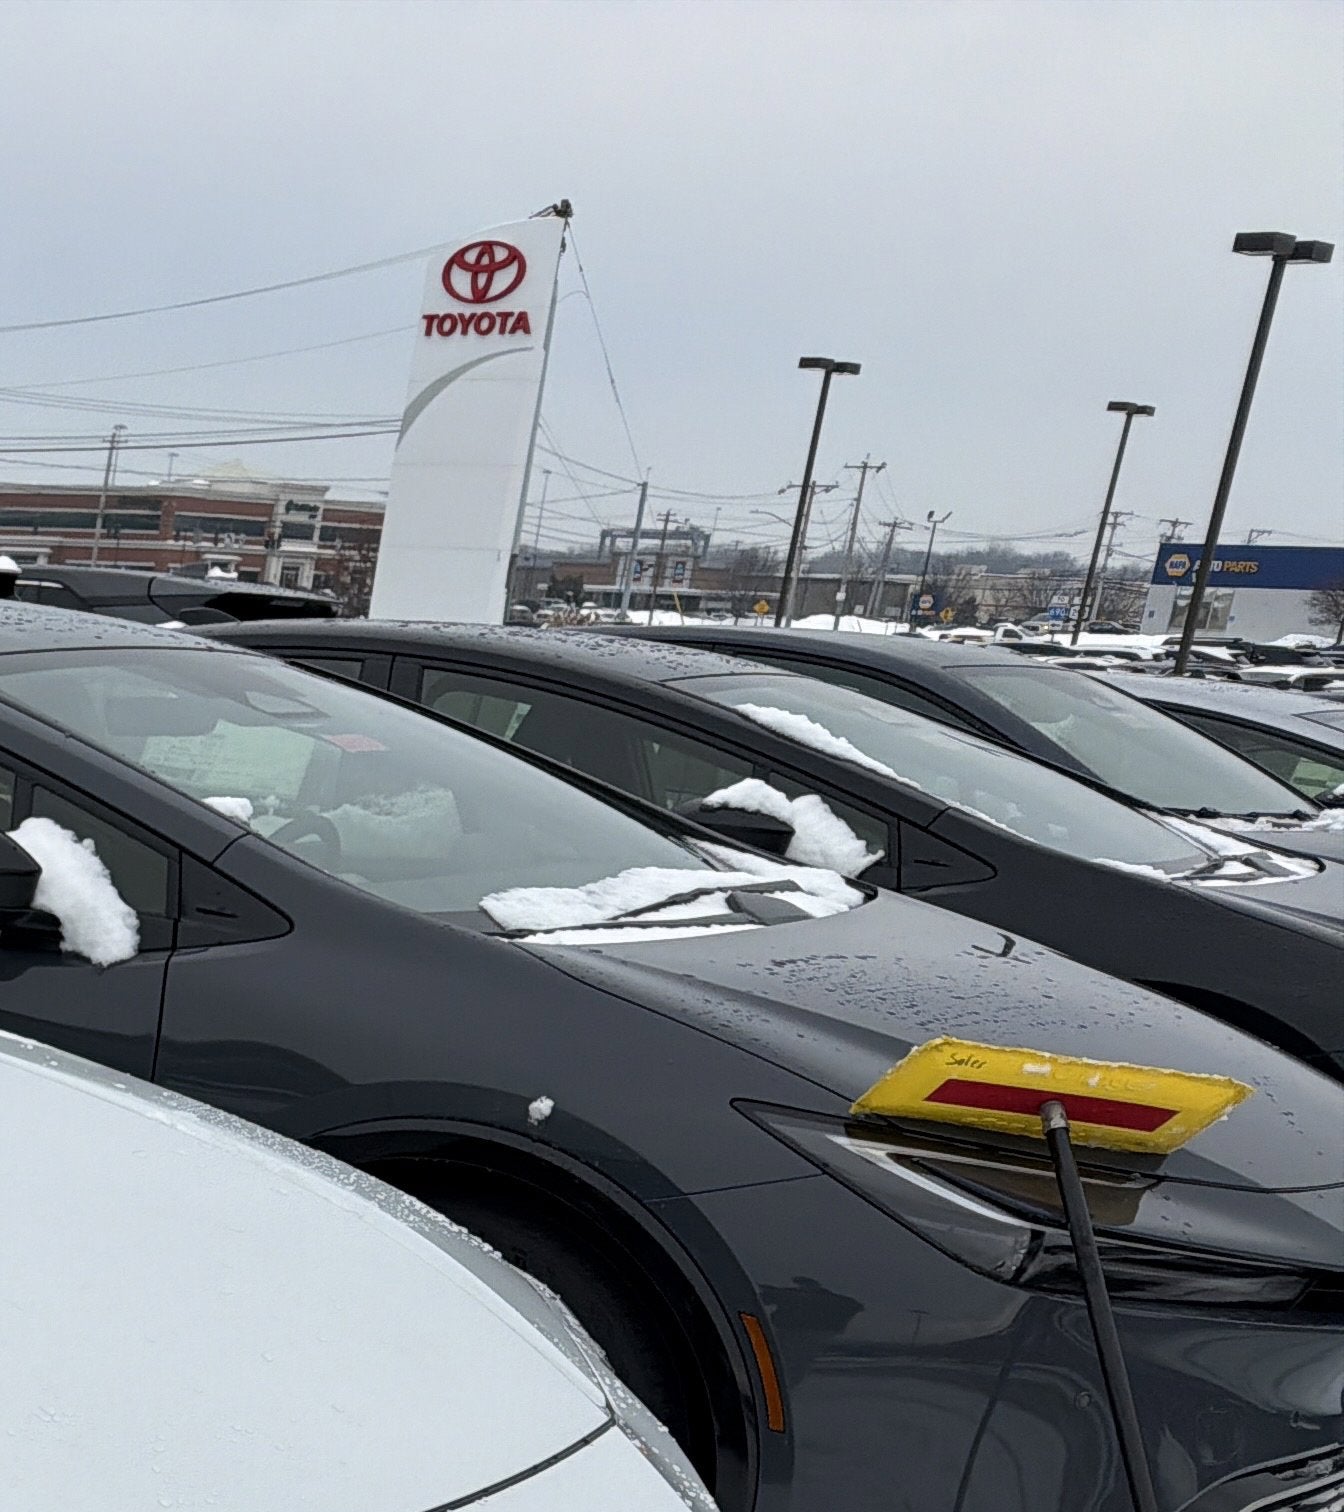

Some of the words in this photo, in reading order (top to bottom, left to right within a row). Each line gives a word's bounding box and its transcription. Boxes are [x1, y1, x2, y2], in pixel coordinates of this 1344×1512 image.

[422, 311, 531, 337] TOYOTA
[1192, 560, 1222, 571] ATO
[1223, 561, 1259, 573] PARTS
